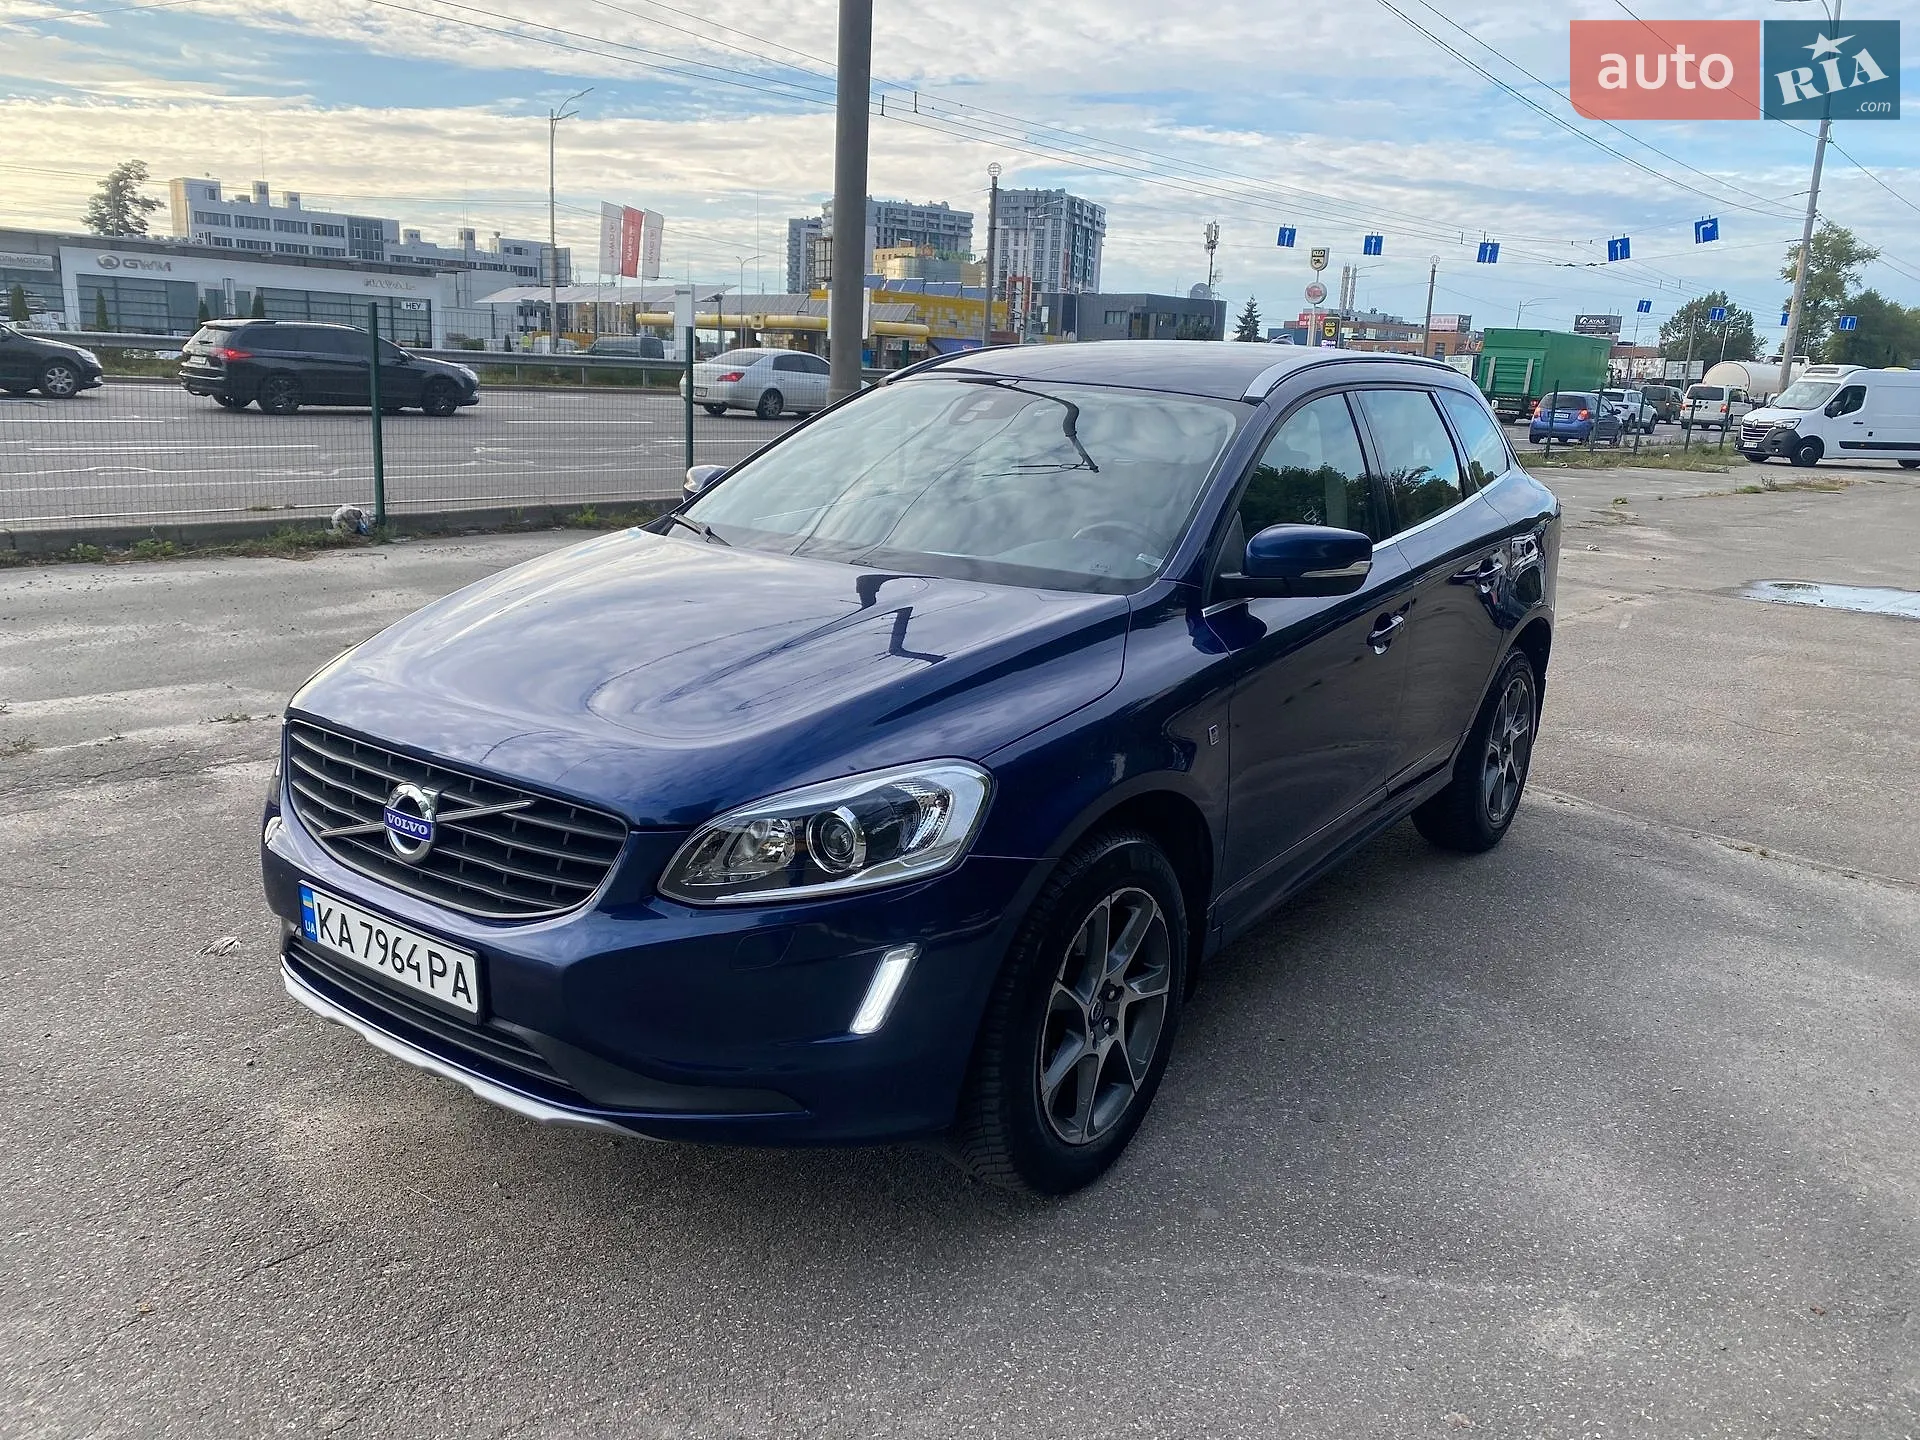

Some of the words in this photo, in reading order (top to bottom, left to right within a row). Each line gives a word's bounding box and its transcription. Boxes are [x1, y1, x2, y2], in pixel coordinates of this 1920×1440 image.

[122, 258, 172, 272] GWM
[405, 302, 421, 310] HEY
[386, 812, 428, 836] VOLVO
[304, 919, 316, 935] UA
[316, 902, 356, 954] KA
[359, 920, 422, 984] 7964
[426, 948, 473, 1005] PA
